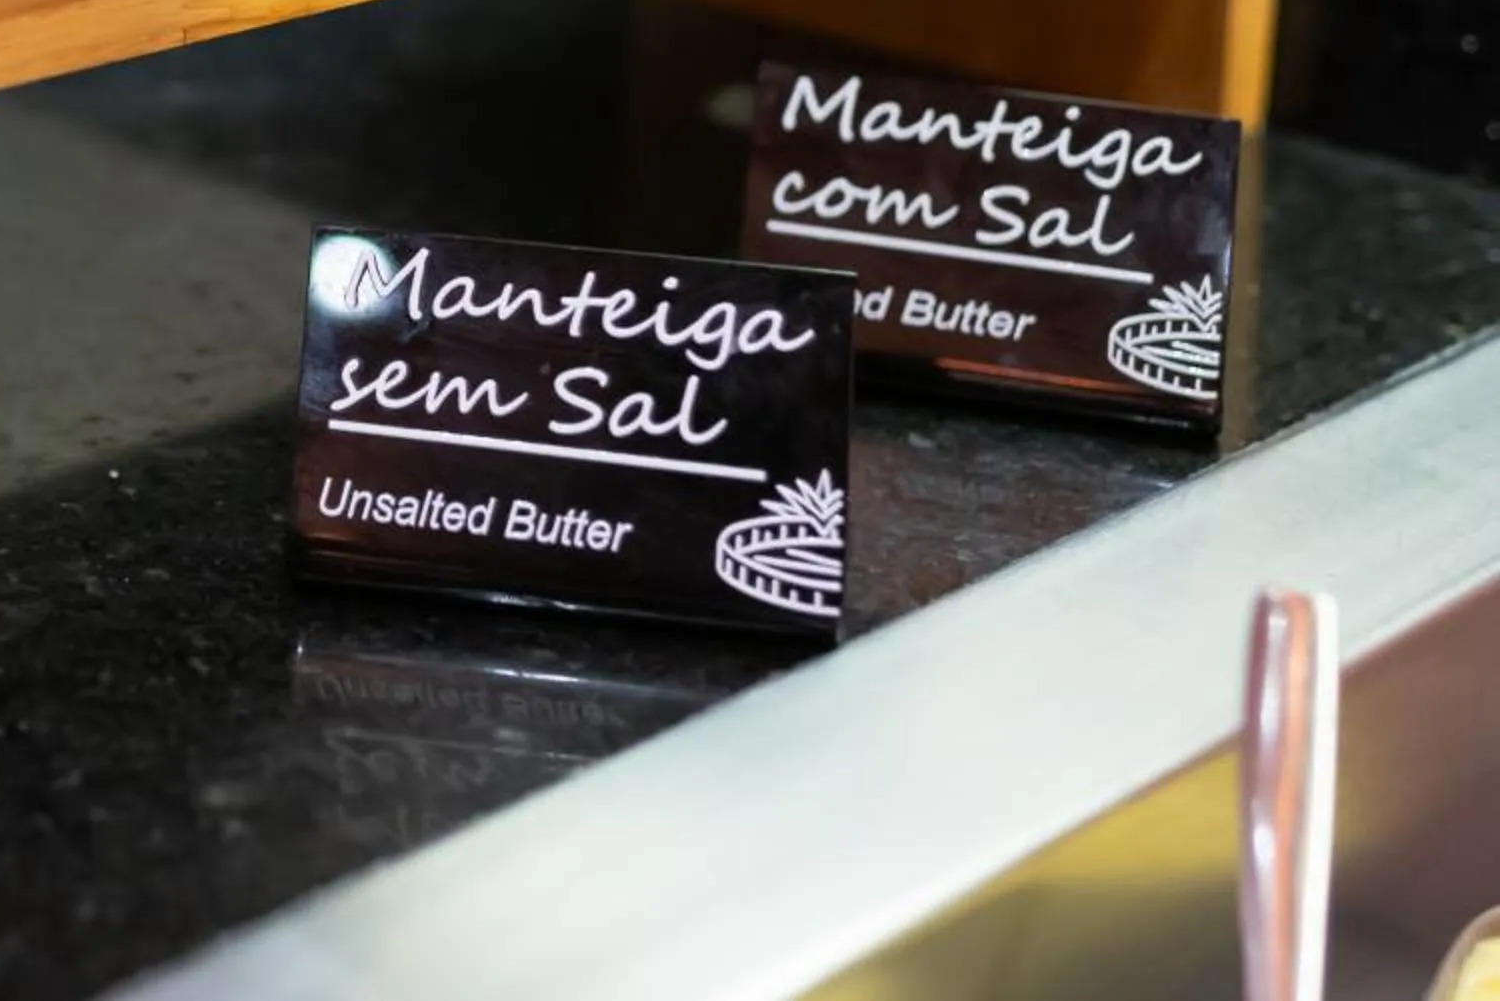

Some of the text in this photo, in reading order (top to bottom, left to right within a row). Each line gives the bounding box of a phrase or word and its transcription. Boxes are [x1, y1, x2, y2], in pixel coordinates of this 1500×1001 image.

[780, 75, 1202, 190] Manteiga
[772, 170, 1135, 256] com Sal
[344, 247, 815, 370] Manteiga
[901, 289, 1037, 341] Butter
[329, 357, 728, 445] sem Sal
[317, 476, 633, 553] Unsalted Butter
